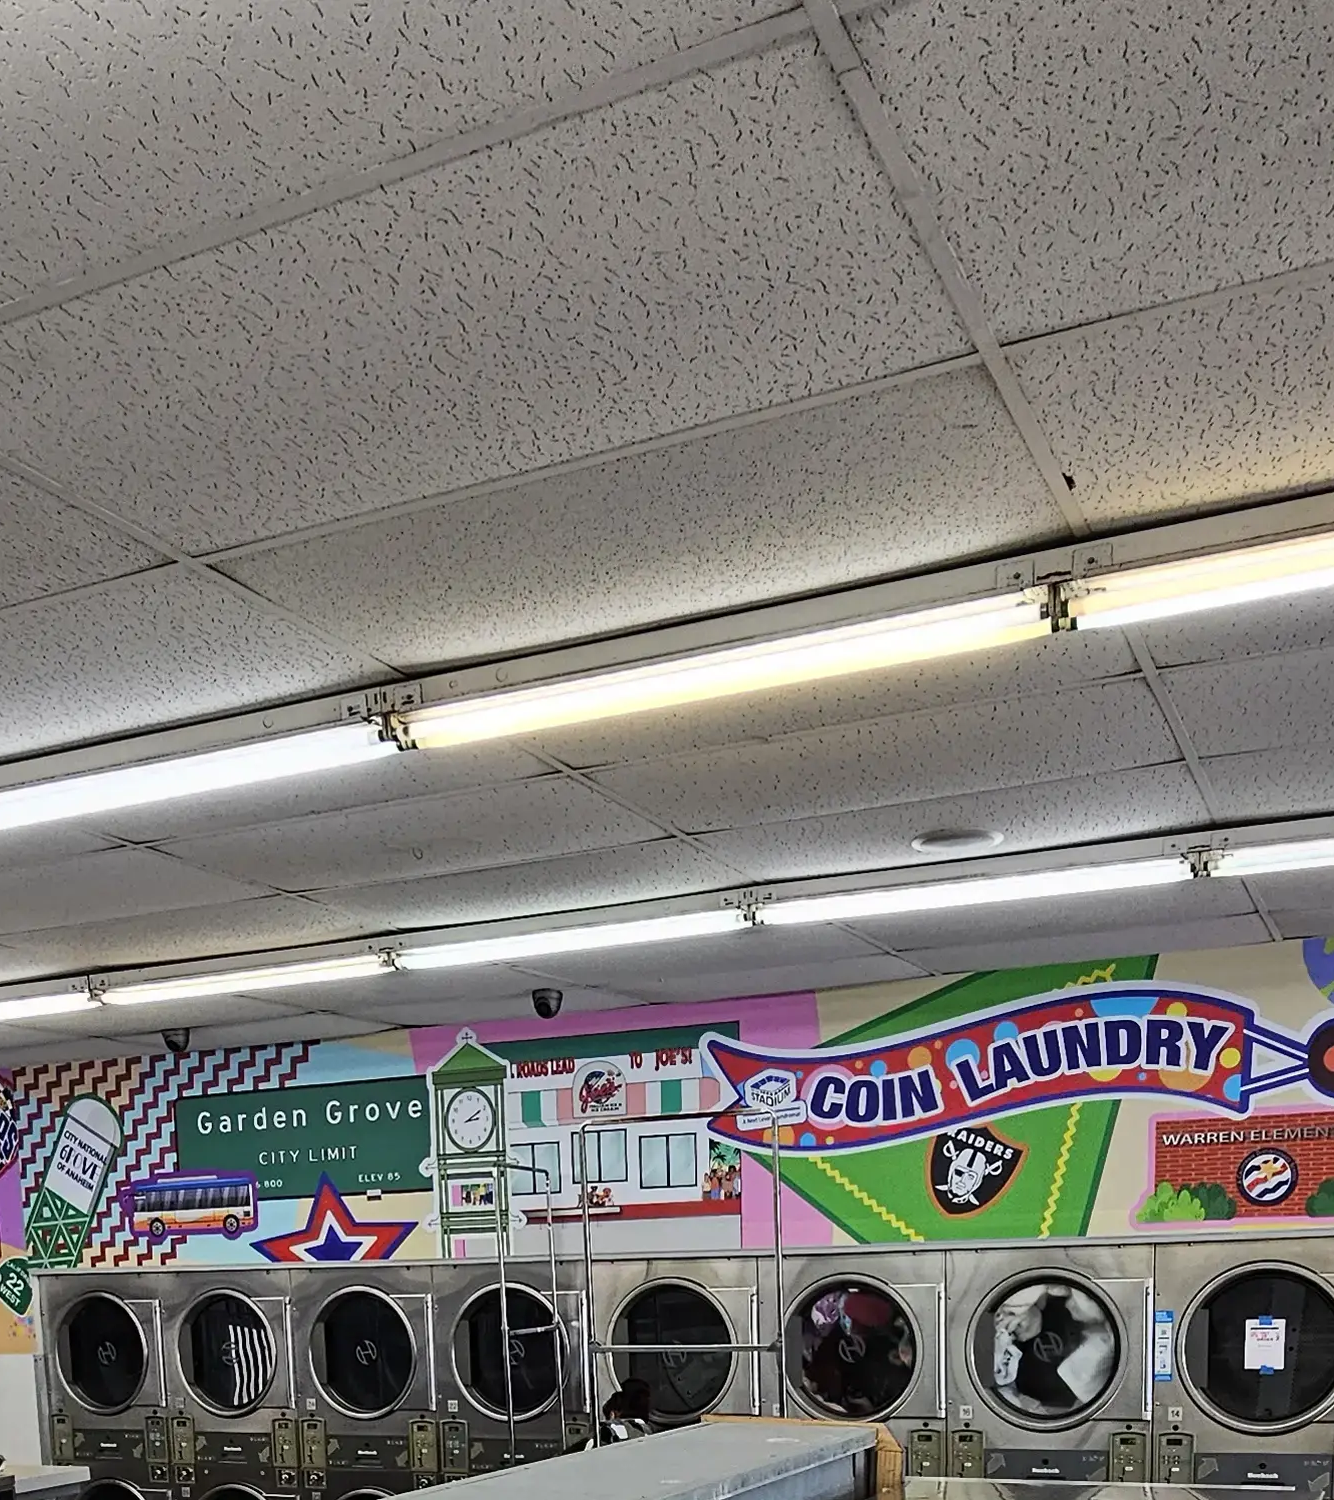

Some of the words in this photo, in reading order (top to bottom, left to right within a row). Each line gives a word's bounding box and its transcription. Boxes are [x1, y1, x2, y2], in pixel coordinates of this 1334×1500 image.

[629, 1052, 643, 1069] TO
[811, 1071, 940, 1122] COIN
[956, 1019, 1230, 1097] LAUNDRY
[751, 1086, 791, 1107] STADIUM
[197, 1106, 308, 1135] Garden
[325, 1099, 423, 1125] Grove
[64, 1131, 79, 1144] CITY
[78, 1140, 108, 1166] NATIONAL
[1163, 1131, 1244, 1147] WARREN
[259, 1150, 300, 1165] CITY
[309, 1145, 358, 1163] LIMIT
[57, 1162, 66, 1171] OF
[65, 1168, 94, 1192] ANAHEIM
[264, 1179, 284, 1188] 800
[358, 1173, 384, 1184] ELEV
[387, 1172, 401, 1182] 85
[5, 1272, 25, 1296] 22
[0, 1283, 21, 1307] WEST
[1170, 1409, 1180, 1418] 14
